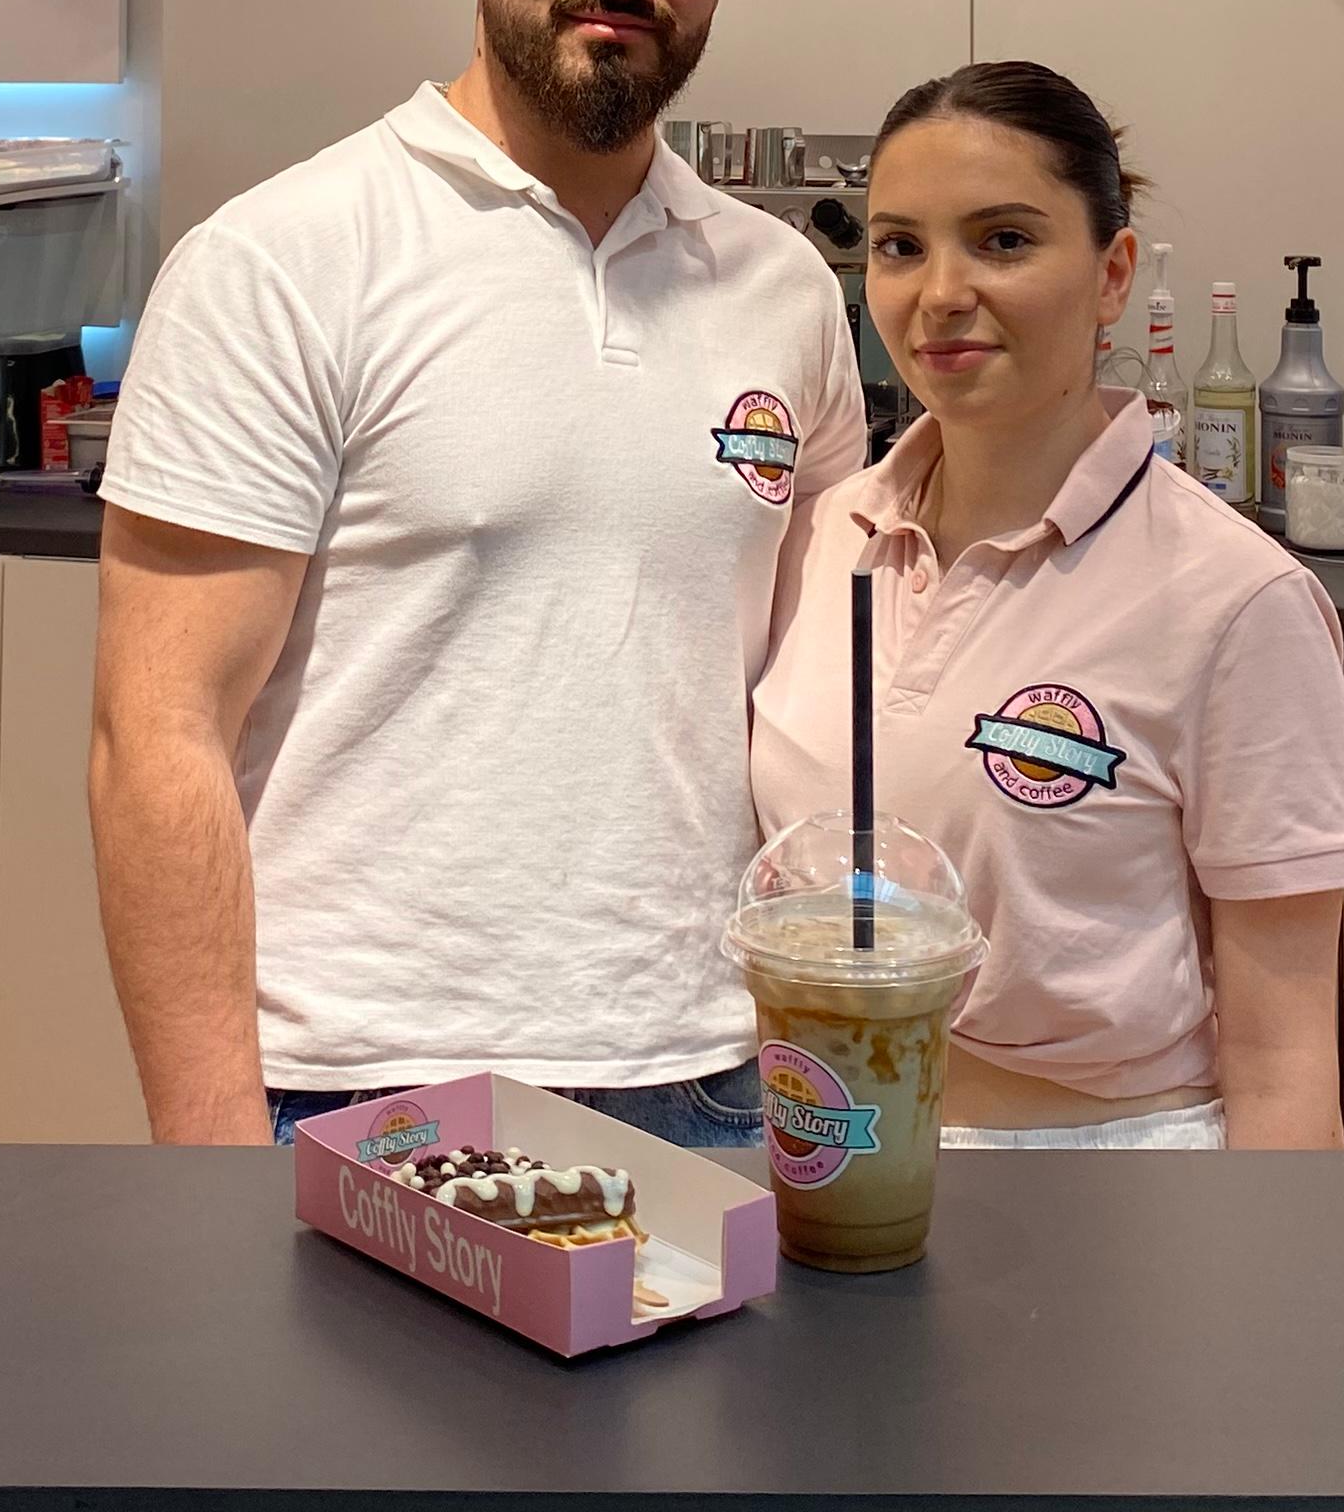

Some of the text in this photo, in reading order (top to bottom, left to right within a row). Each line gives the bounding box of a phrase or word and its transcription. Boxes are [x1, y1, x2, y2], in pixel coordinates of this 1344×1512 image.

[1273, 431, 1312, 440] MONIN
[988, 723, 1098, 774] Coffly Story
[993, 762, 1073, 800] and coffee
[398, 1129, 427, 1147] Story
[792, 1106, 850, 1144] Story
[338, 1165, 502, 1314] Coffly Story
